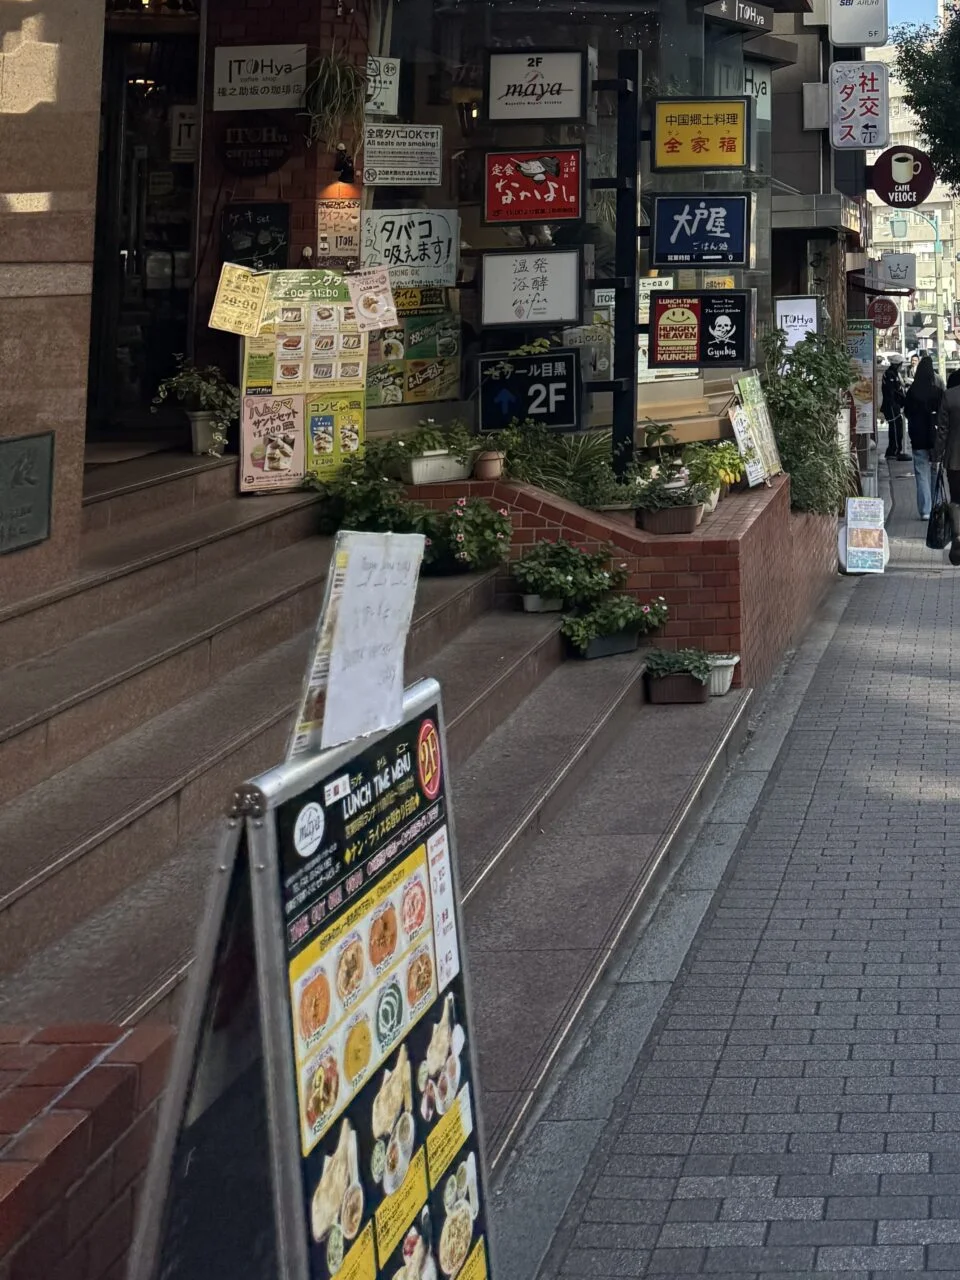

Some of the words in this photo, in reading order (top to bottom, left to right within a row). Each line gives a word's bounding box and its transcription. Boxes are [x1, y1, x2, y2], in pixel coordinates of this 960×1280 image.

[527, 57, 543, 67] 2F
[859, 72, 879, 117] 社交
[666, 113, 738, 126] 中国郷土料理
[839, 83, 857, 141] ダンス
[664, 137, 737, 154] 全家福
[491, 163, 515, 176] 定食
[888, 192, 917, 202] VELOCE
[895, 184, 910, 192] CAFFE
[380, 220, 432, 243] タバコ
[670, 201, 731, 244] 大戸屋
[692, 241, 729, 250] ごはん処
[512, 259, 530, 292] 温浴
[532, 257, 549, 291] 発酵
[707, 345, 737, 358] Gyubig
[527, 382, 567, 414] 2F
[418, 728, 438, 786] 2F
[343, 782, 371, 820] LUNCH
[373, 768, 391, 796] TIME
[391, 751, 411, 783] MENU
